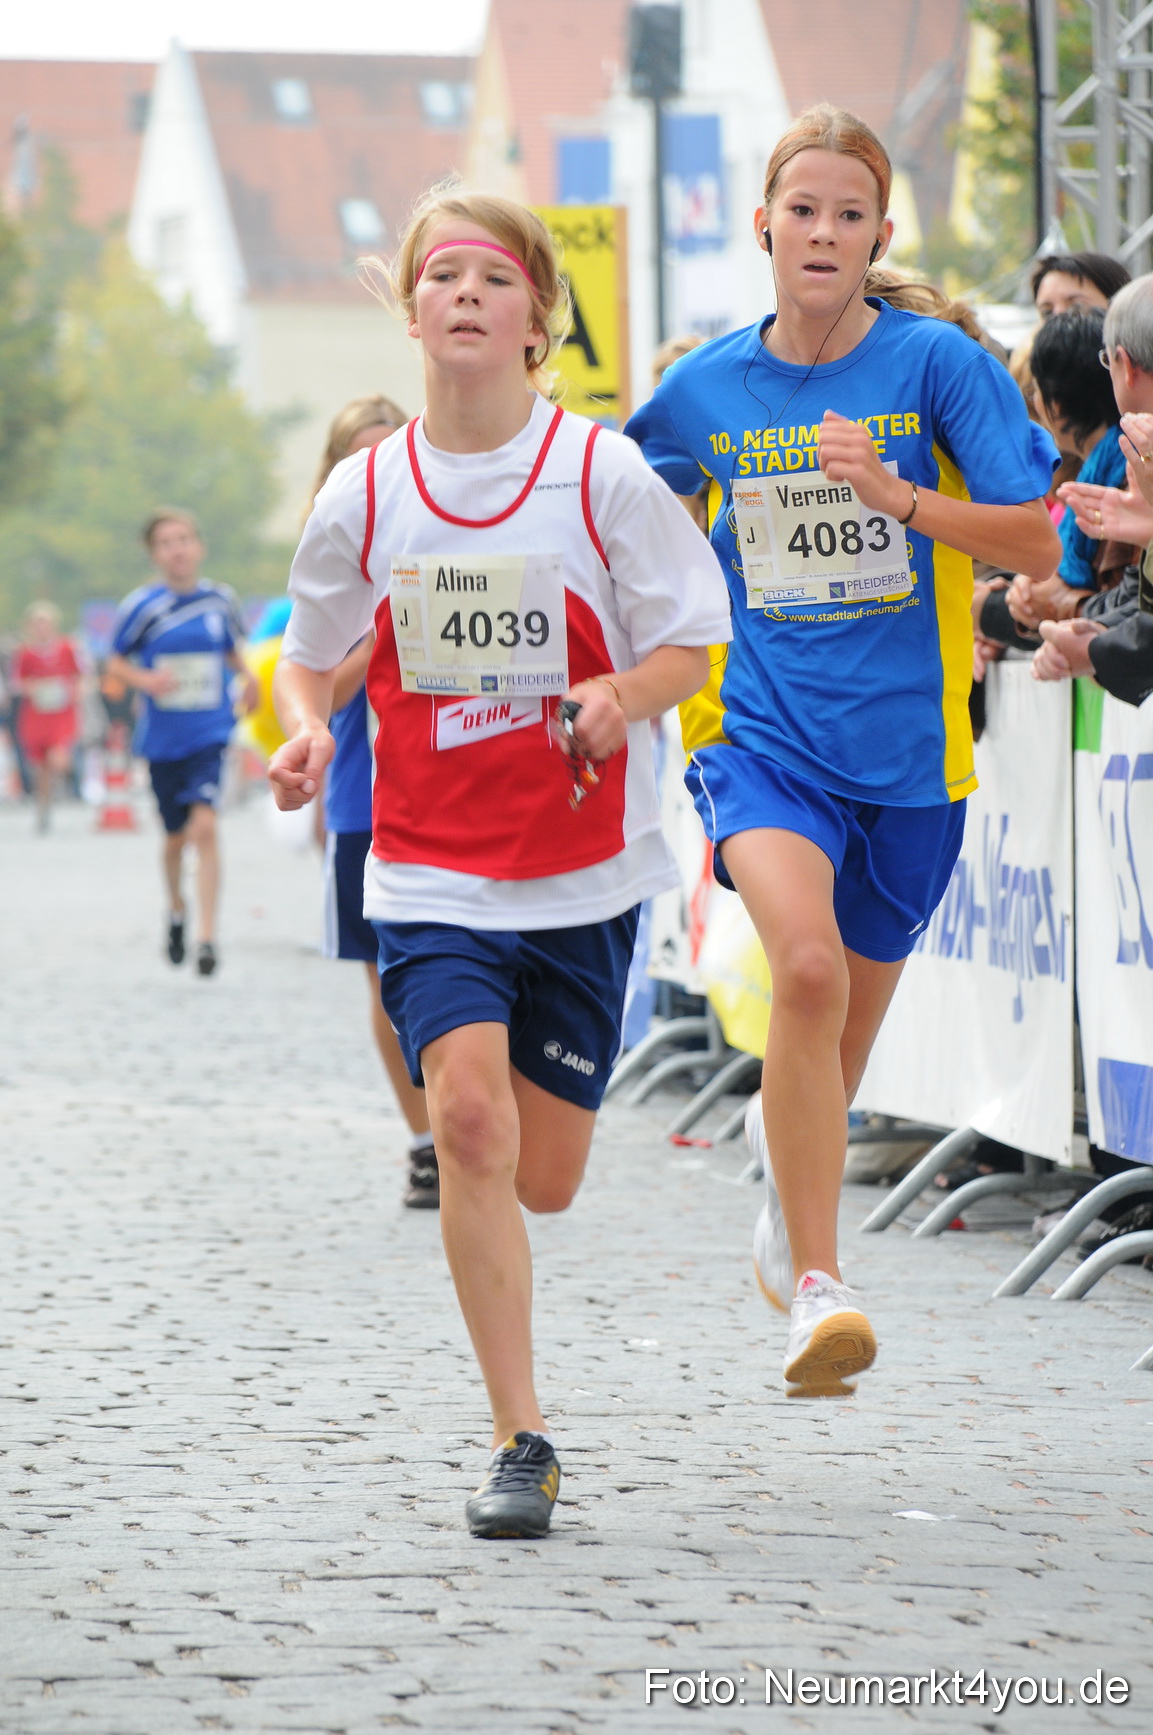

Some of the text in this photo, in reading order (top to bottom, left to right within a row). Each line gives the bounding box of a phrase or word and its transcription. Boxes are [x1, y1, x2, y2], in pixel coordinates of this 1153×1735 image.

[709, 412, 921, 455] 10. NEUMKTER
[535, 481, 580, 491] BROOKS
[775, 484, 853, 509] Verena
[747, 526, 756, 544] J
[787, 516, 891, 558] 4083
[436, 566, 488, 592] Alina
[846, 571, 909, 591] PFLEIDERER
[763, 587, 806, 600] BOCK
[400, 608, 409, 627] J
[440, 610, 550, 648] 4039
[500, 672, 566, 686] PFLEIDERER
[463, 702, 512, 731] DEHN
[561, 1051, 596, 1076] JAKO
